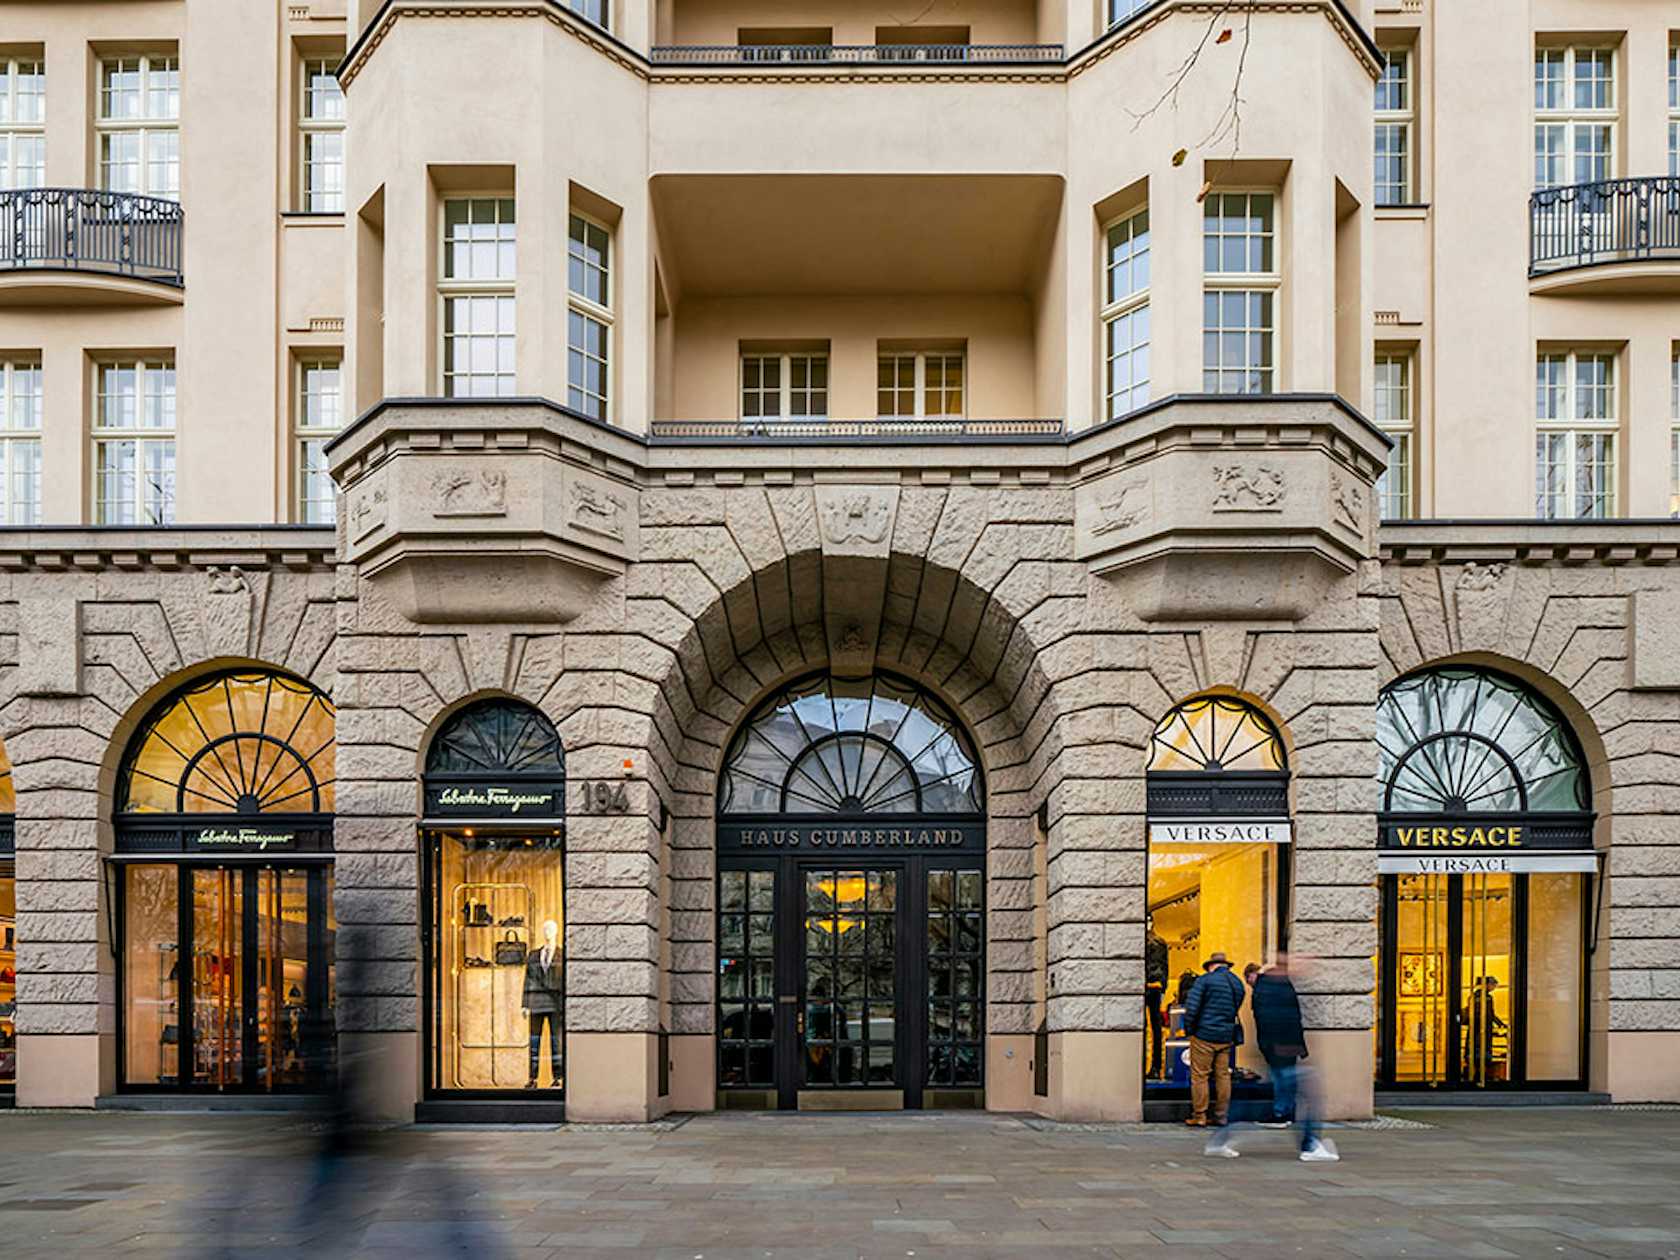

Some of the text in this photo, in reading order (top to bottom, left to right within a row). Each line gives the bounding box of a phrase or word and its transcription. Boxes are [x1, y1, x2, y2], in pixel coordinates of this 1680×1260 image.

[580, 780, 630, 813] 194
[740, 829, 964, 846] HAUS CUMBERLAND
[1166, 826, 1275, 841] VERSACE
[1396, 826, 1522, 847] VERSACE
[1418, 858, 1510, 872] VERSACE
